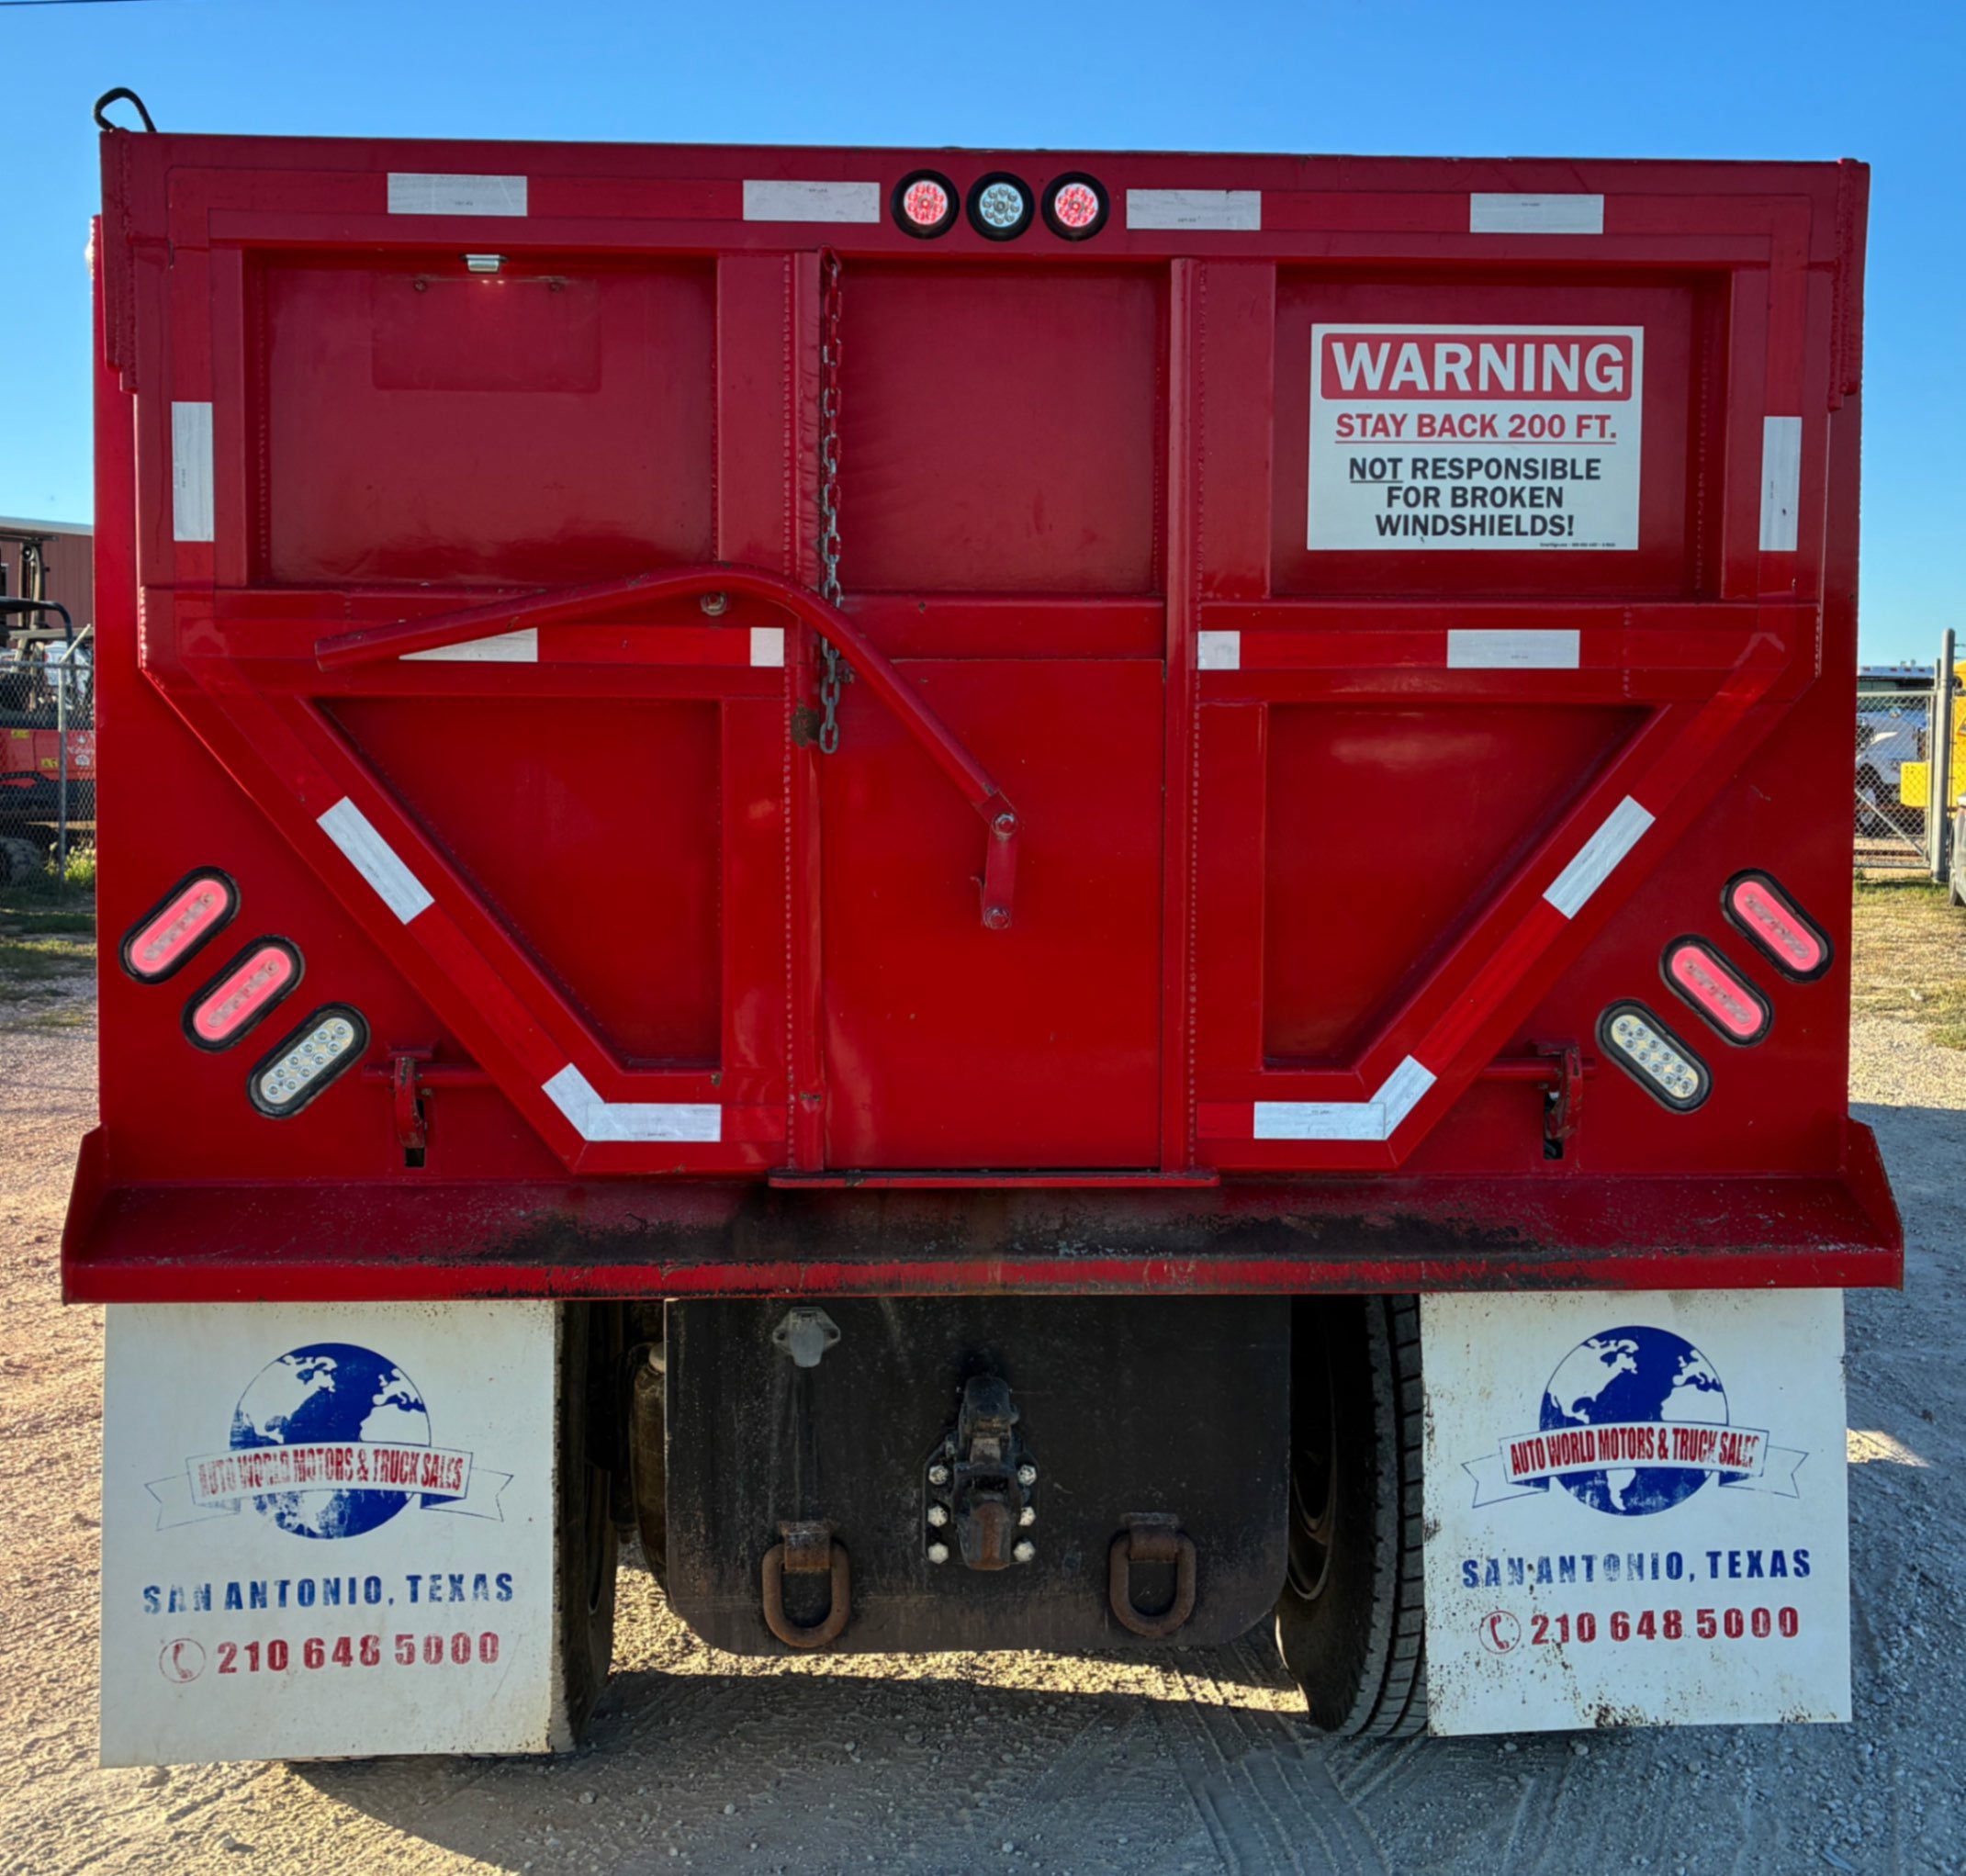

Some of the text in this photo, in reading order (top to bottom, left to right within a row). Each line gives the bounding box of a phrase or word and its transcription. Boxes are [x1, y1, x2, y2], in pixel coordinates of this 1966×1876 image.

[1331, 342, 1624, 393] WARNING
[1335, 413, 1617, 439] STAY BACK 200 FT.
[1349, 457, 1601, 480] NOT RESPONSIBLE
[1387, 486, 1563, 509] FOR BROKEN
[1376, 514, 1575, 536] WINDSHIELDS!
[1511, 1427, 1759, 1476] AUTO WORLD MOTORS & TRUCK SALES
[198, 1456, 236, 1498] AUTO
[293, 1447, 354, 1483] MOTORS
[357, 1448, 369, 1482] &
[373, 1448, 420, 1485] TRUCK
[421, 1453, 464, 1491] SALES
[1462, 1548, 1811, 1589] SAN ANTONIO, TEXAS
[142, 1572, 513, 1615] SAN ANTONIO, TEXAS
[1531, 1606, 1799, 1646] 210 648 5000
[217, 1631, 500, 1674] 210 648 5000
